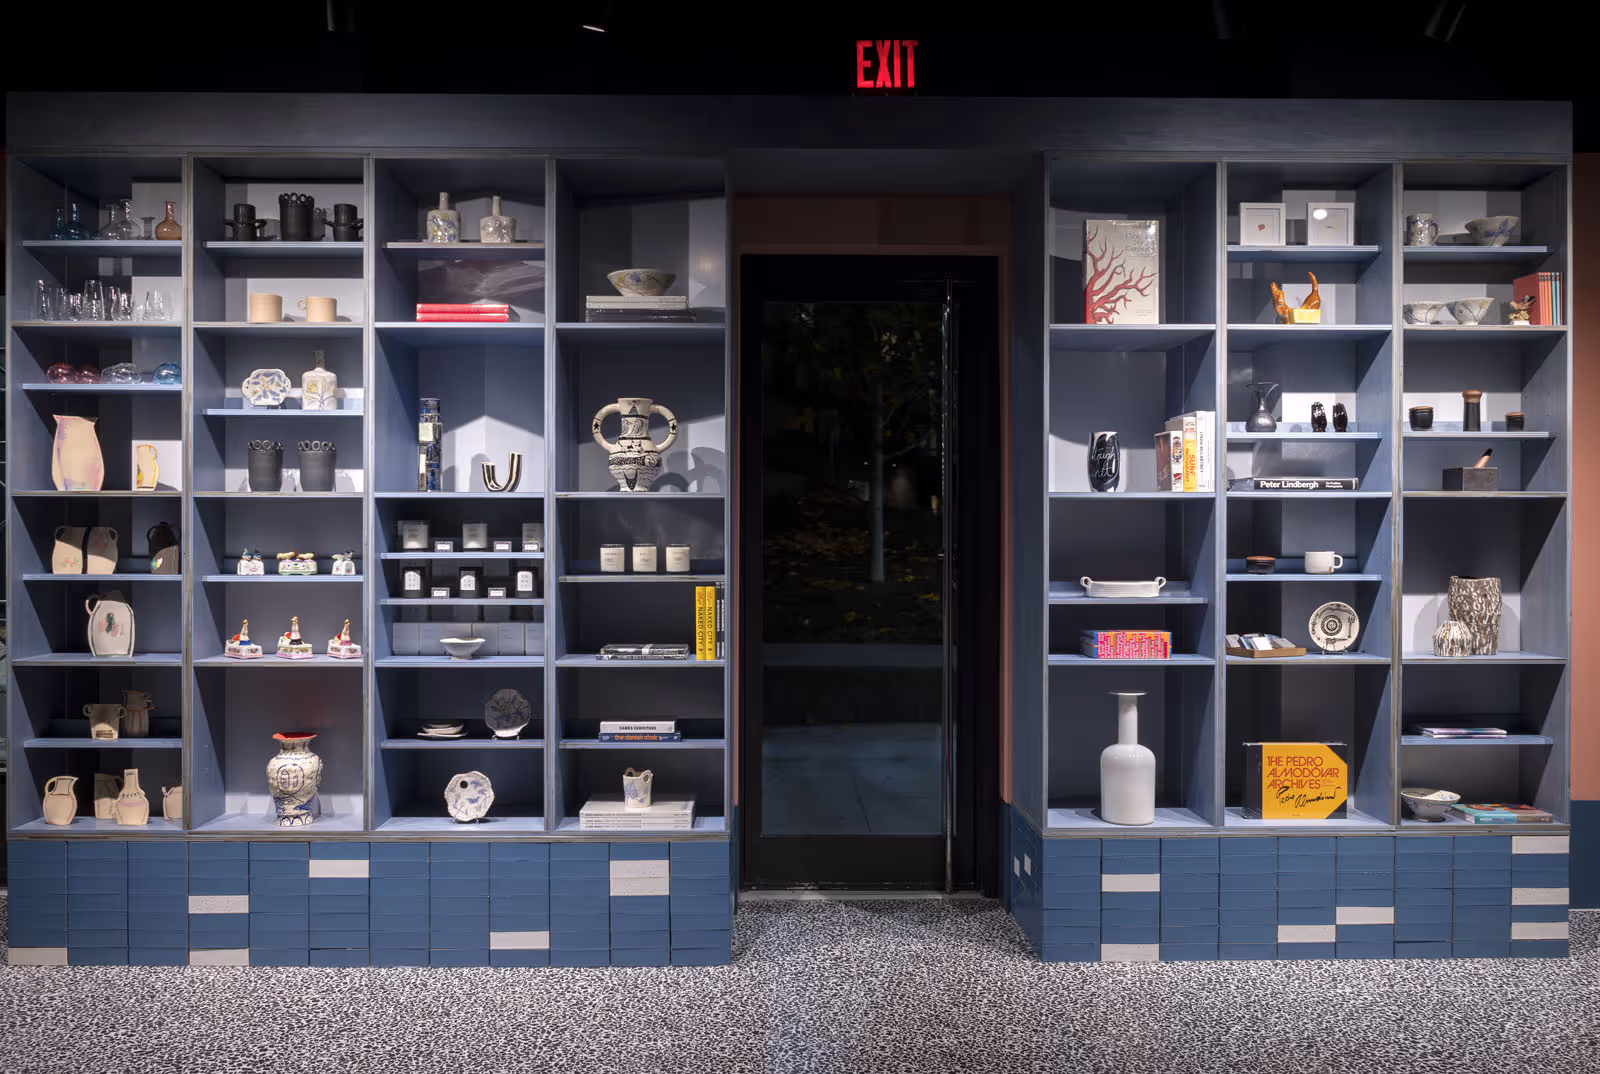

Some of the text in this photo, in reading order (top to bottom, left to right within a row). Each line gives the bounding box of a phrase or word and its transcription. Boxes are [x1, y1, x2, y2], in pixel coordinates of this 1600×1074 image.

[856, 40, 919, 88] EXIT
[1260, 480, 1319, 489] Peter Lindbergh
[1266, 756, 1324, 767] THE PEDRO
[1266, 779, 1321, 789] ARCHIVES
